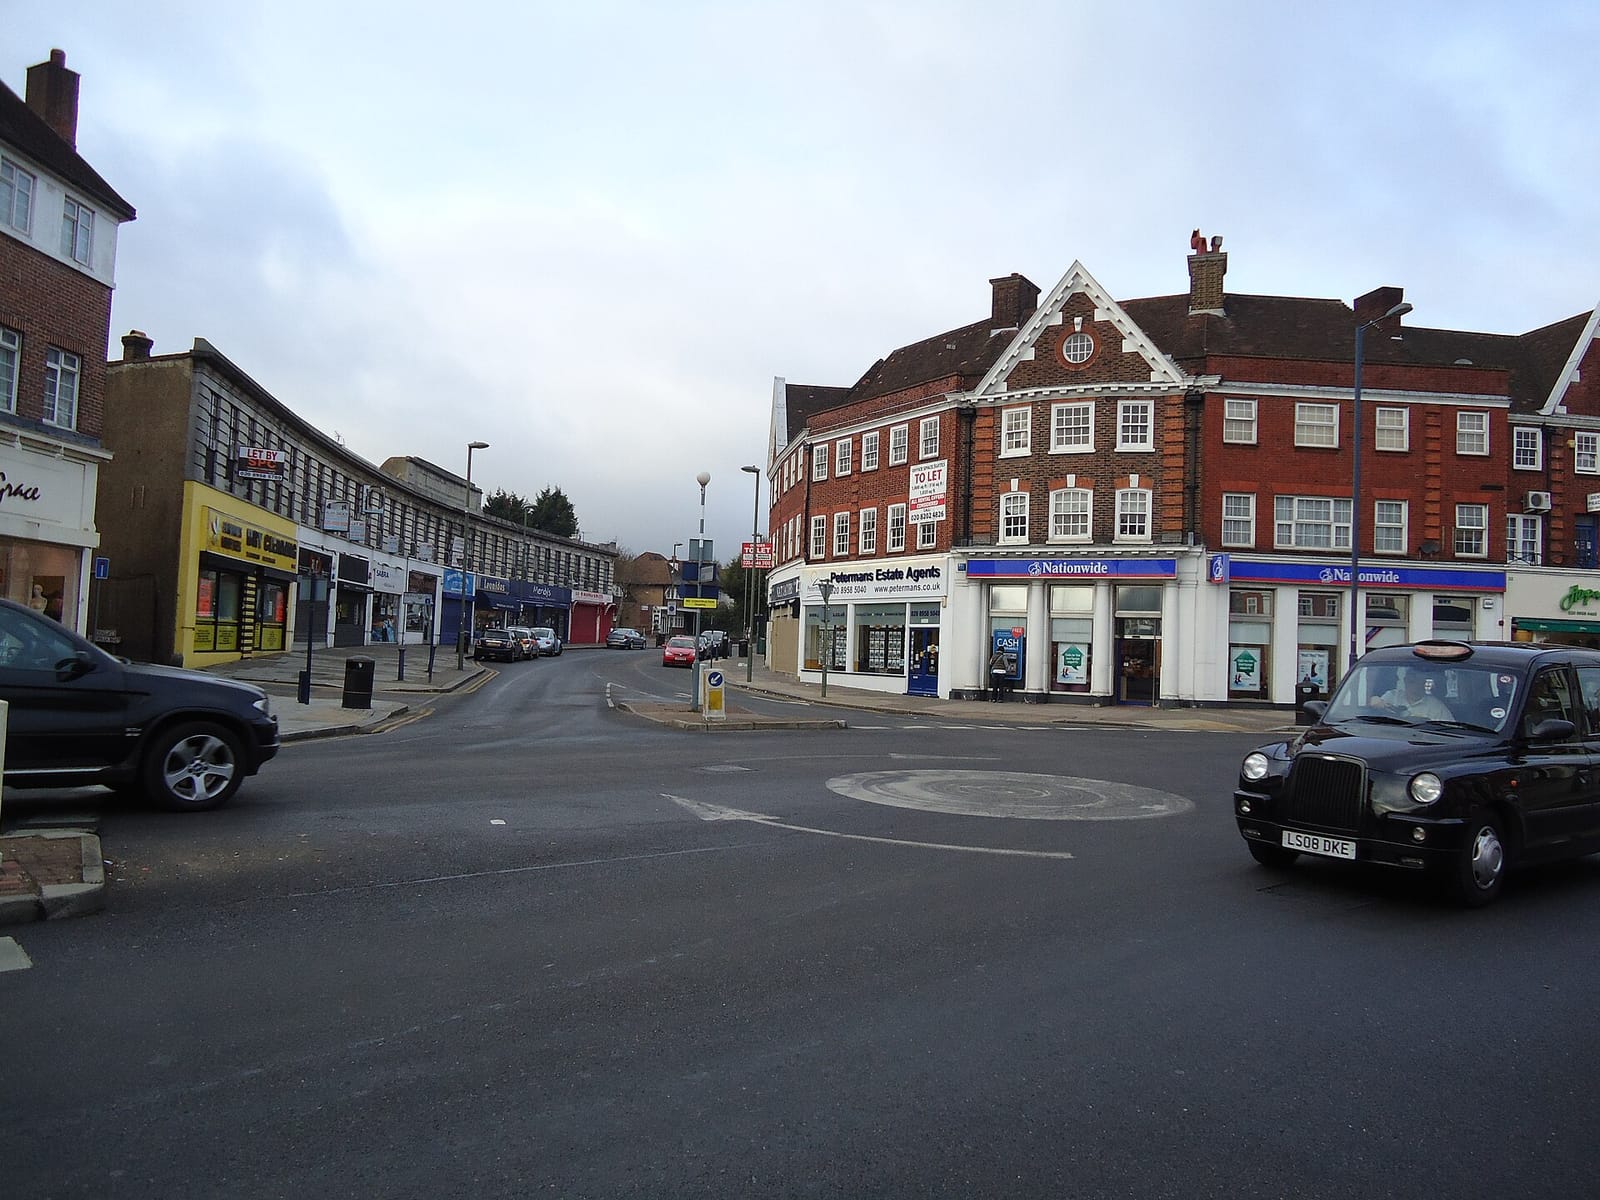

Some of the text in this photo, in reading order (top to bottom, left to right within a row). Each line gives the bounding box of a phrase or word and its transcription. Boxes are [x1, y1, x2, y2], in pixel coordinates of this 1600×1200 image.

[248, 449, 278, 460] LET BY
[915, 469, 942, 484] TO LET
[830, 565, 941, 584] Petermans Estate Agents
[1042, 561, 1108, 574] Nationwide
[1334, 568, 1400, 583] Naonwide
[841, 585, 853, 594] 8958
[854, 585, 867, 593] 5040
[874, 582, 940, 593] www.petermans.co.uk
[997, 638, 1018, 647] CASH
[1288, 833, 1349, 855] LS08 DKE
